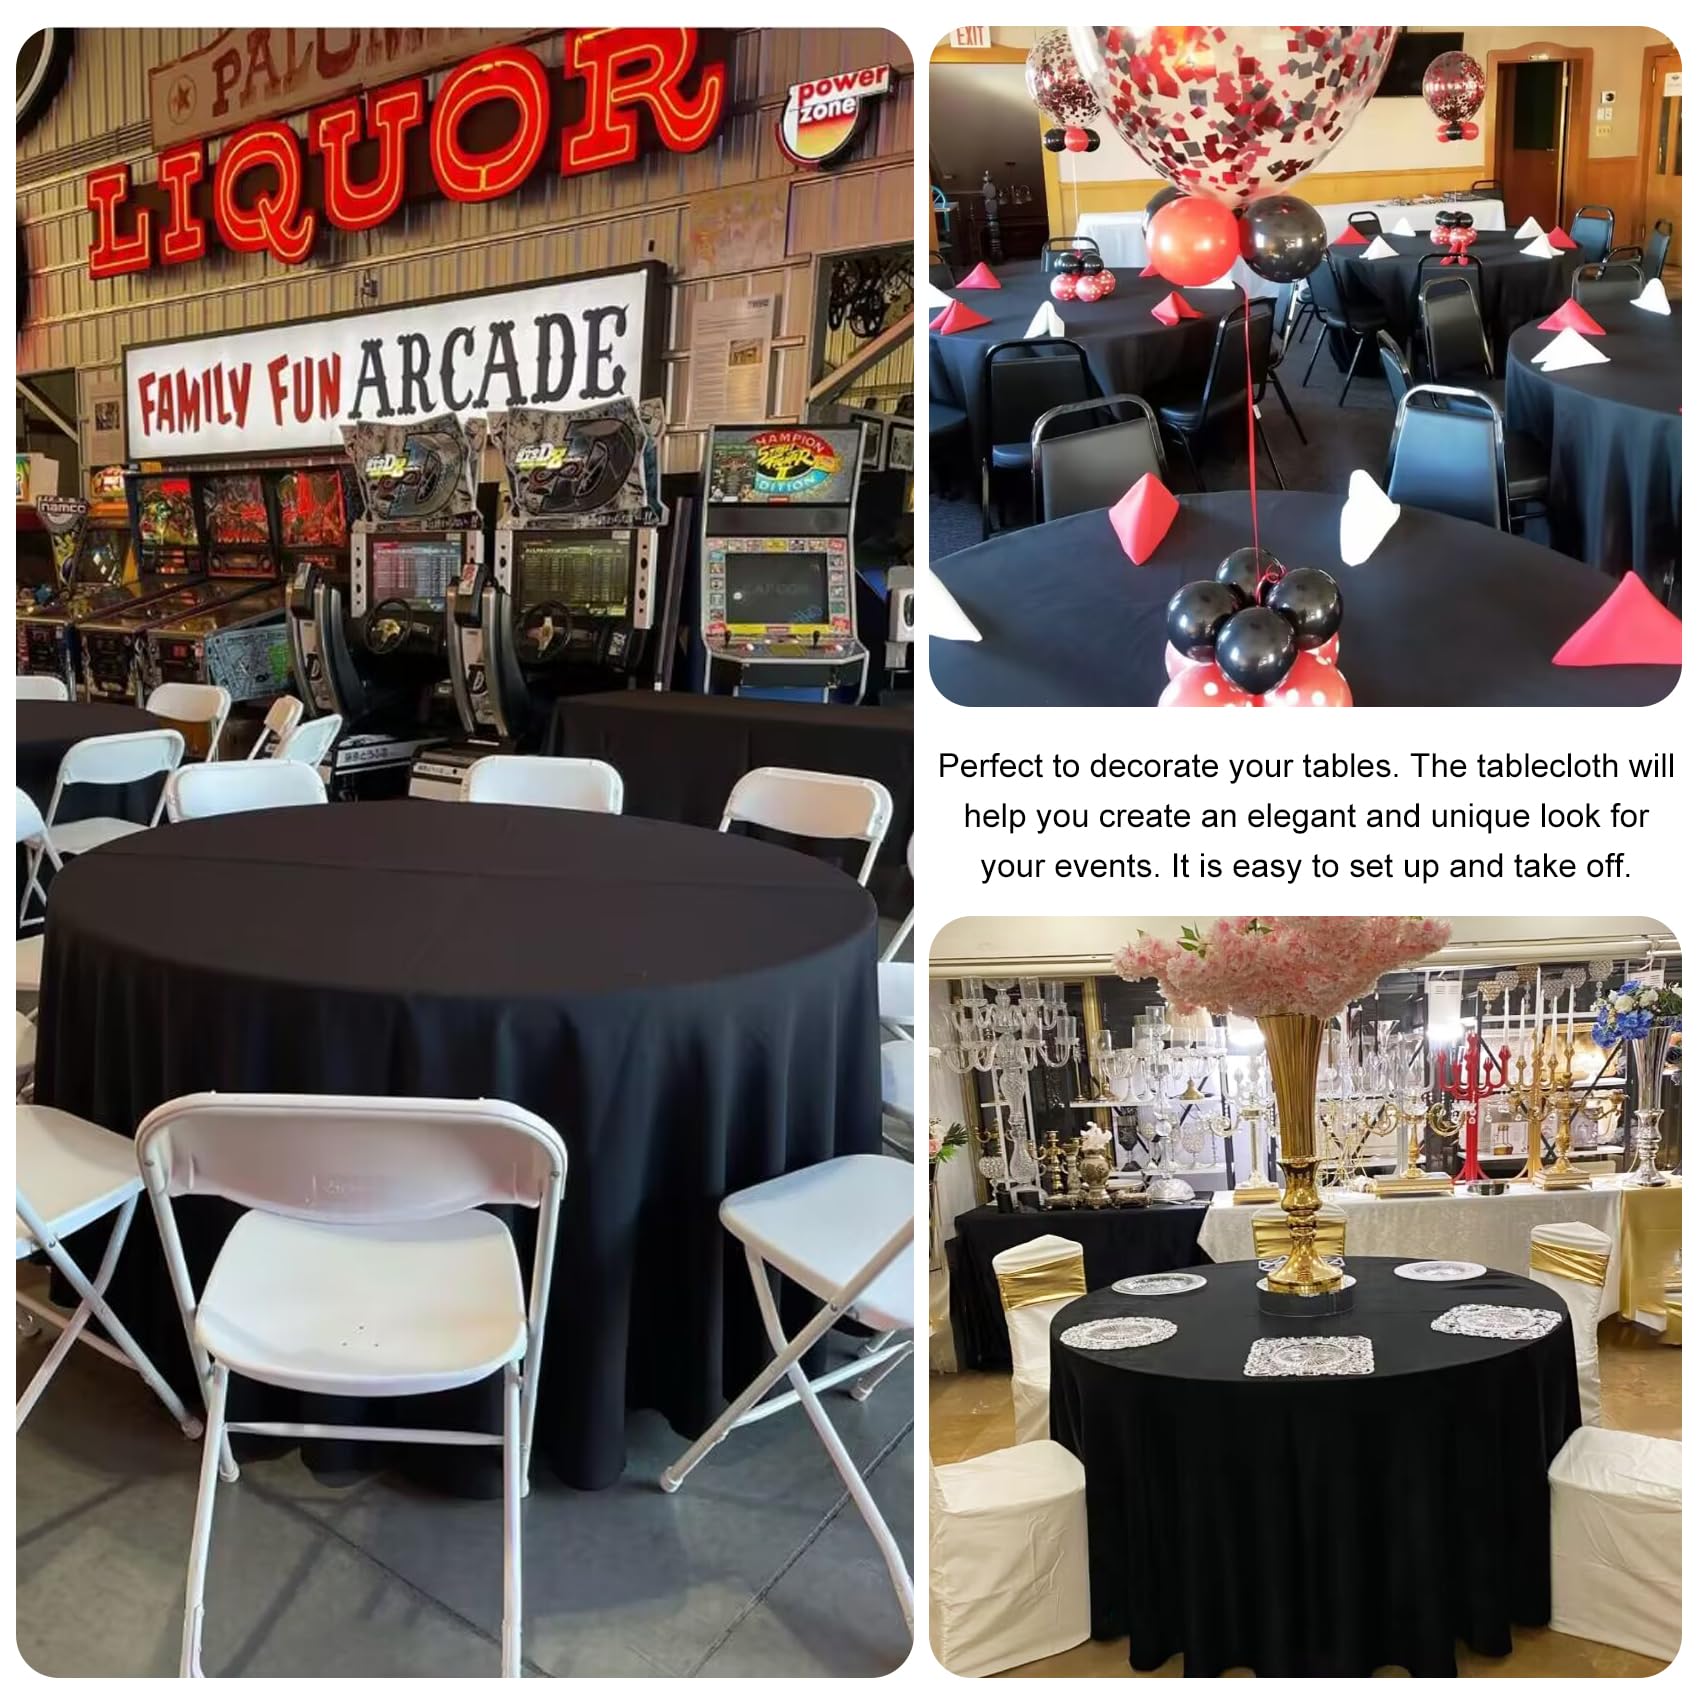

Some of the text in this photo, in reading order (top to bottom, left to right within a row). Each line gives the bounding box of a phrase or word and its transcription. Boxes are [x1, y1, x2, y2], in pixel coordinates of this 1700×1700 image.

[956, 26, 985, 46] EXIT
[798, 63, 889, 107] power
[799, 97, 856, 124] zone
[87, 28, 726, 280] LIQUOR
[138, 361, 252, 437] FAMILY
[267, 351, 341, 427] FUN
[347, 303, 631, 419] ARCADE
[755, 432, 825, 453] HAMPION
[756, 476, 816, 492] DITION
[41, 502, 87, 513] namco
